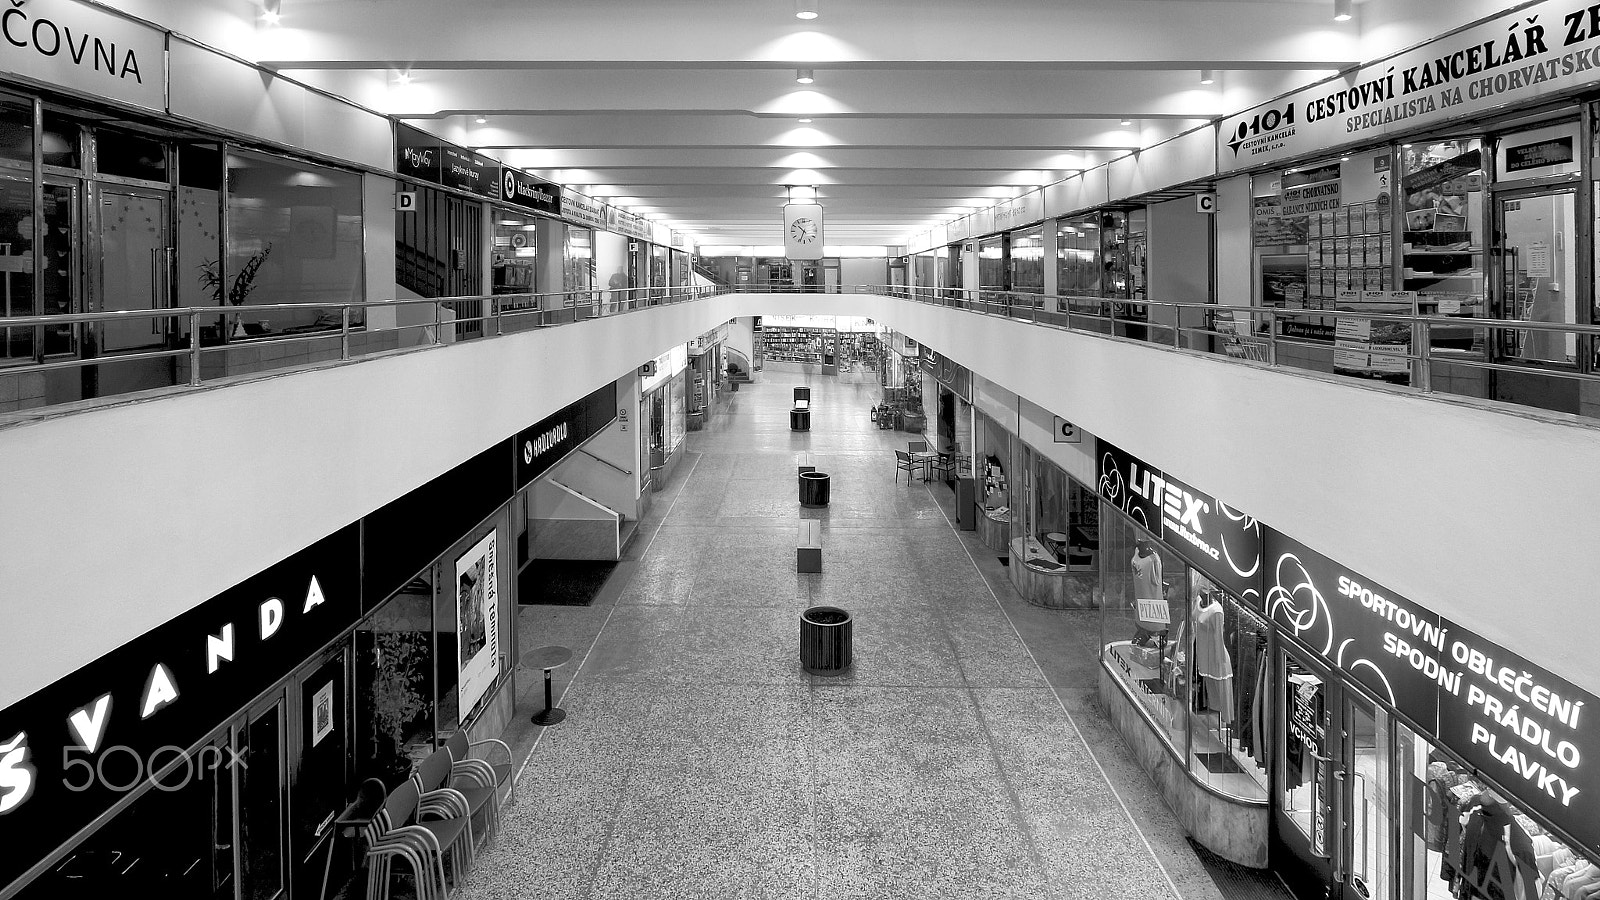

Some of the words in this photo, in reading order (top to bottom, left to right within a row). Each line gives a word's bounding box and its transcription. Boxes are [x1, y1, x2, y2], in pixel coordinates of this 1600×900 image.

[1, 0, 142, 84] ČOVNA
[1306, 66, 1395, 123] CESTOVNÍ
[1402, 14, 1549, 95] KANCELÁŘ
[1346, 95, 1436, 133] SPECIALISTA
[1441, 87, 1464, 108] NA
[1243, 136, 1266, 149] CESTOVNÍ
[1267, 128, 1296, 142] KANCELÁŘ
[400, 194, 412, 208] D
[1201, 196, 1212, 210] C
[1302, 182, 1339, 199] CHORVATSKO
[643, 364, 650, 373] D
[533, 421, 567, 458] HADIVADLO
[1062, 422, 1074, 437] C
[1130, 462, 1204, 535] LITEX
[1109, 644, 1132, 678] LITEX
[1337, 575, 1449, 652] SPORTOVNÍ
[1451, 640, 1585, 730] OBLEČENÍ
[0, 574, 326, 815] ŠVANDA
[1383, 631, 1465, 697] SPODNÍ
[1467, 683, 1581, 770] PRÁDLO
[1289, 720, 1318, 754] VCHOD
[1471, 721, 1581, 808] PLAVKY
